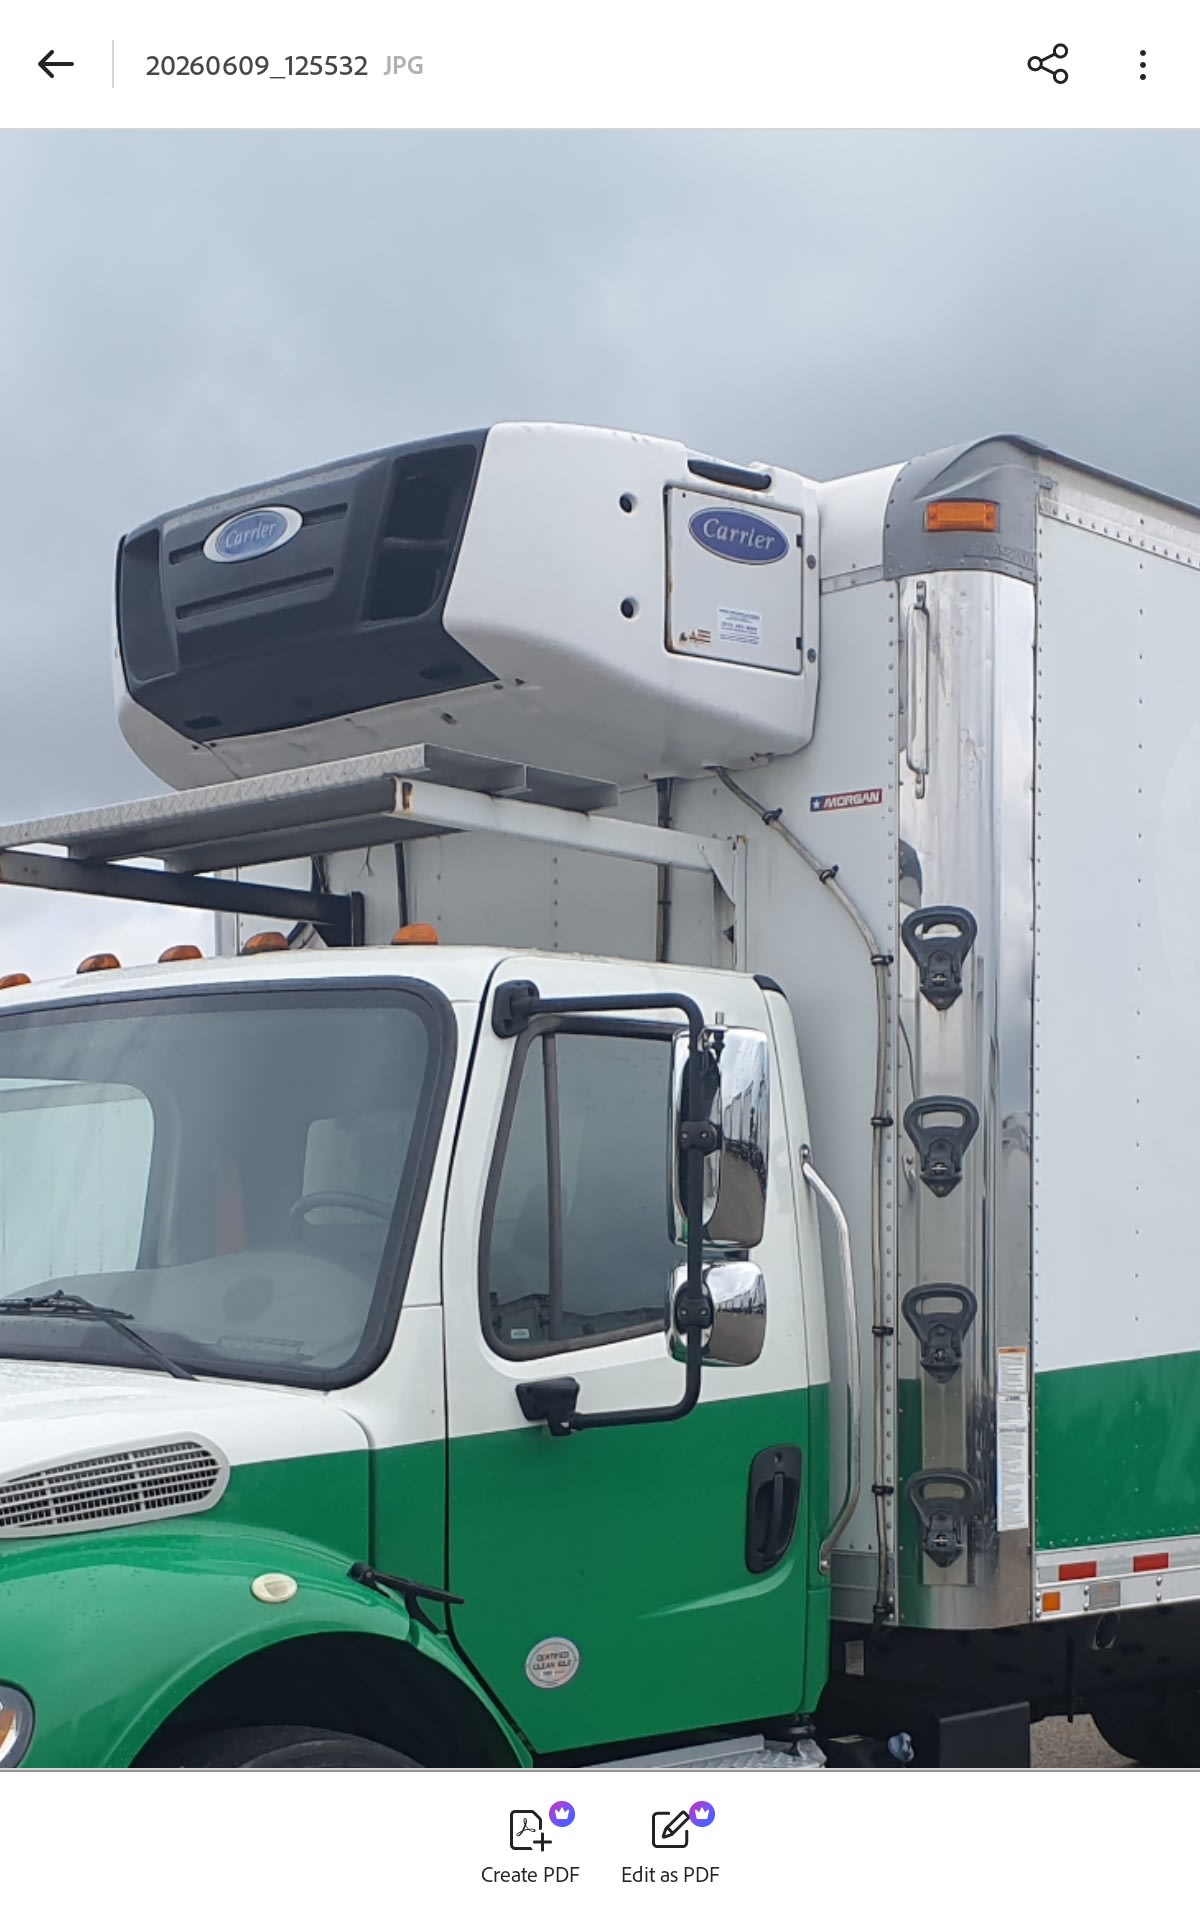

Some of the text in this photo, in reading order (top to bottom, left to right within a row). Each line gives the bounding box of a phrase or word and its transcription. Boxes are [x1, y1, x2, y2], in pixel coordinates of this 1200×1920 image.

[225, 520, 277, 549] Carrier
[702, 518, 776, 550] Carrier
[823, 791, 880, 809] MORGAN
